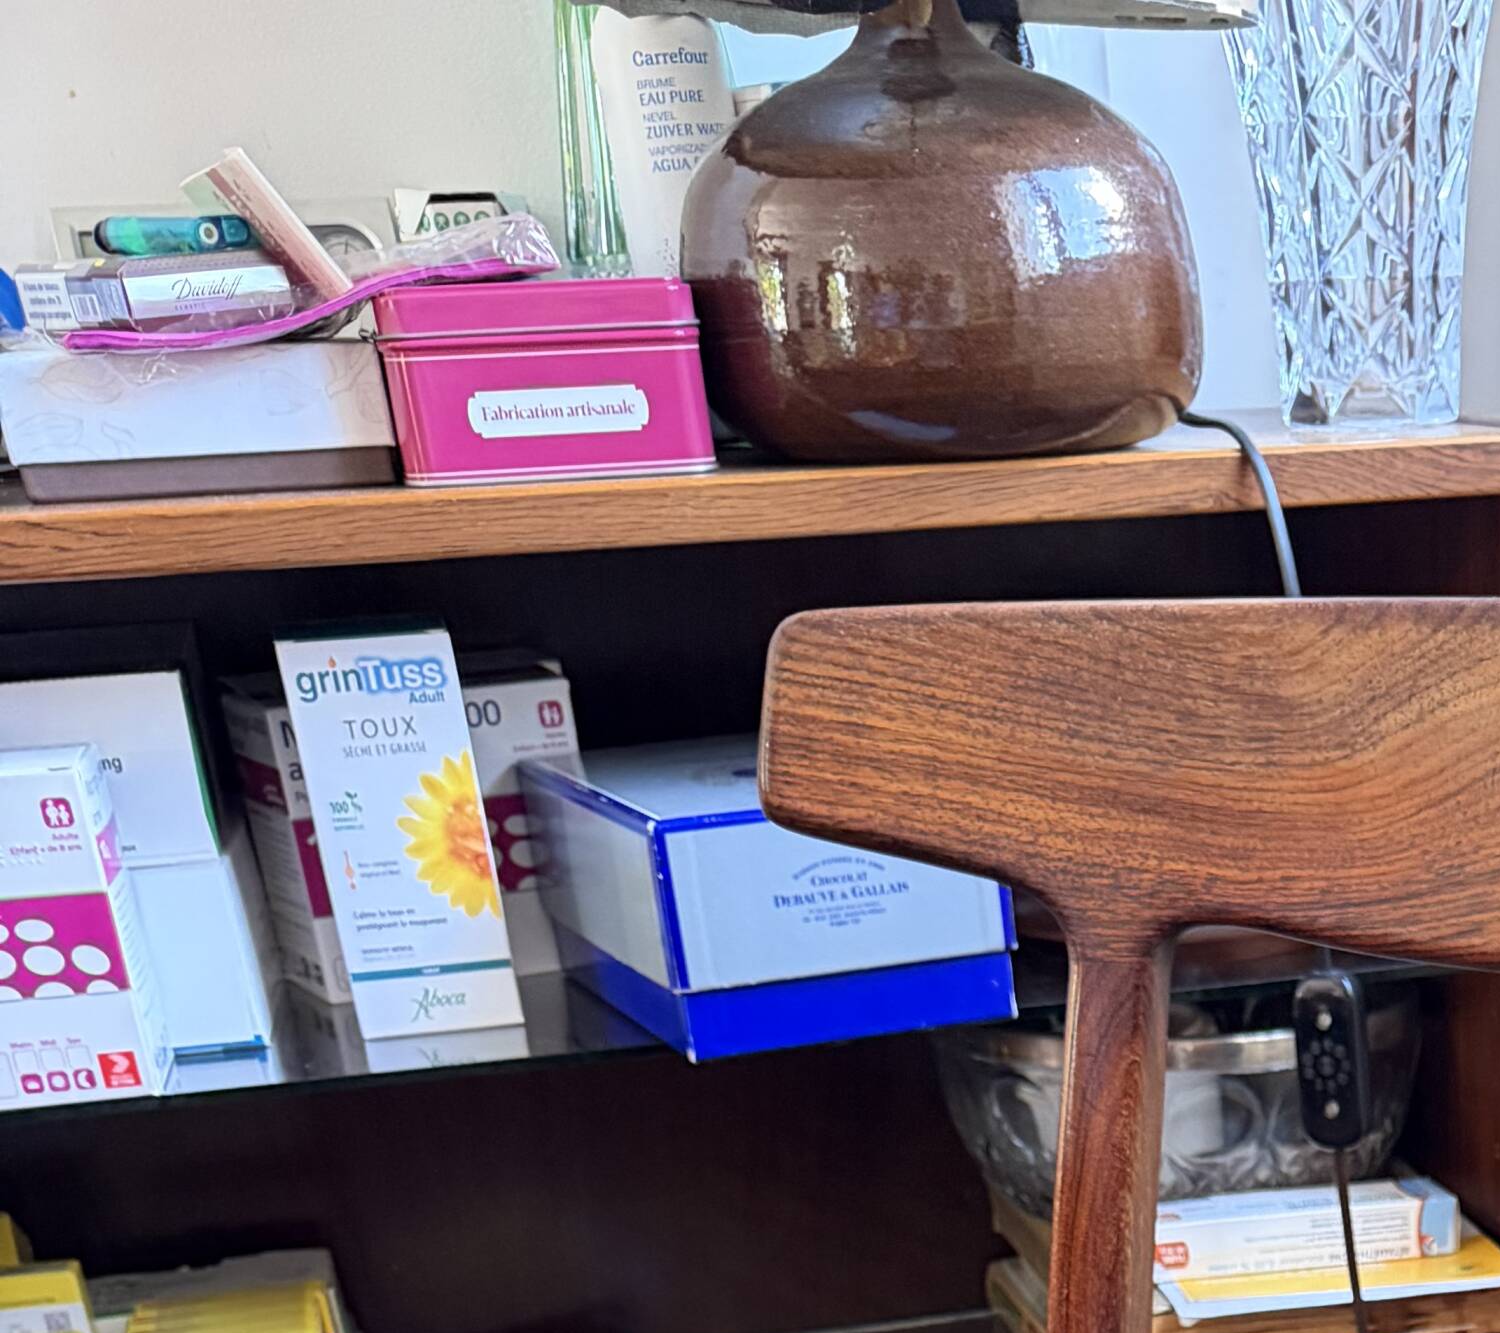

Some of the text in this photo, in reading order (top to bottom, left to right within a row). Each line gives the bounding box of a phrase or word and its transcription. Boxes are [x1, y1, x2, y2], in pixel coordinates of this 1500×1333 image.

[632, 47, 708, 67] Carrefour
[636, 76, 676, 90] BRUME
[639, 89, 705, 106] EAU PURE
[643, 111, 677, 123] NEVEL
[646, 123, 694, 140] ZUIVER
[652, 157, 692, 173] AGUA
[171, 274, 243, 299] Davidoff
[481, 399, 636, 421] Fabrication artisanale
[409, 690, 445, 704] Adult
[343, 715, 417, 740] TOUX
[411, 987, 466, 1023] Aboca
